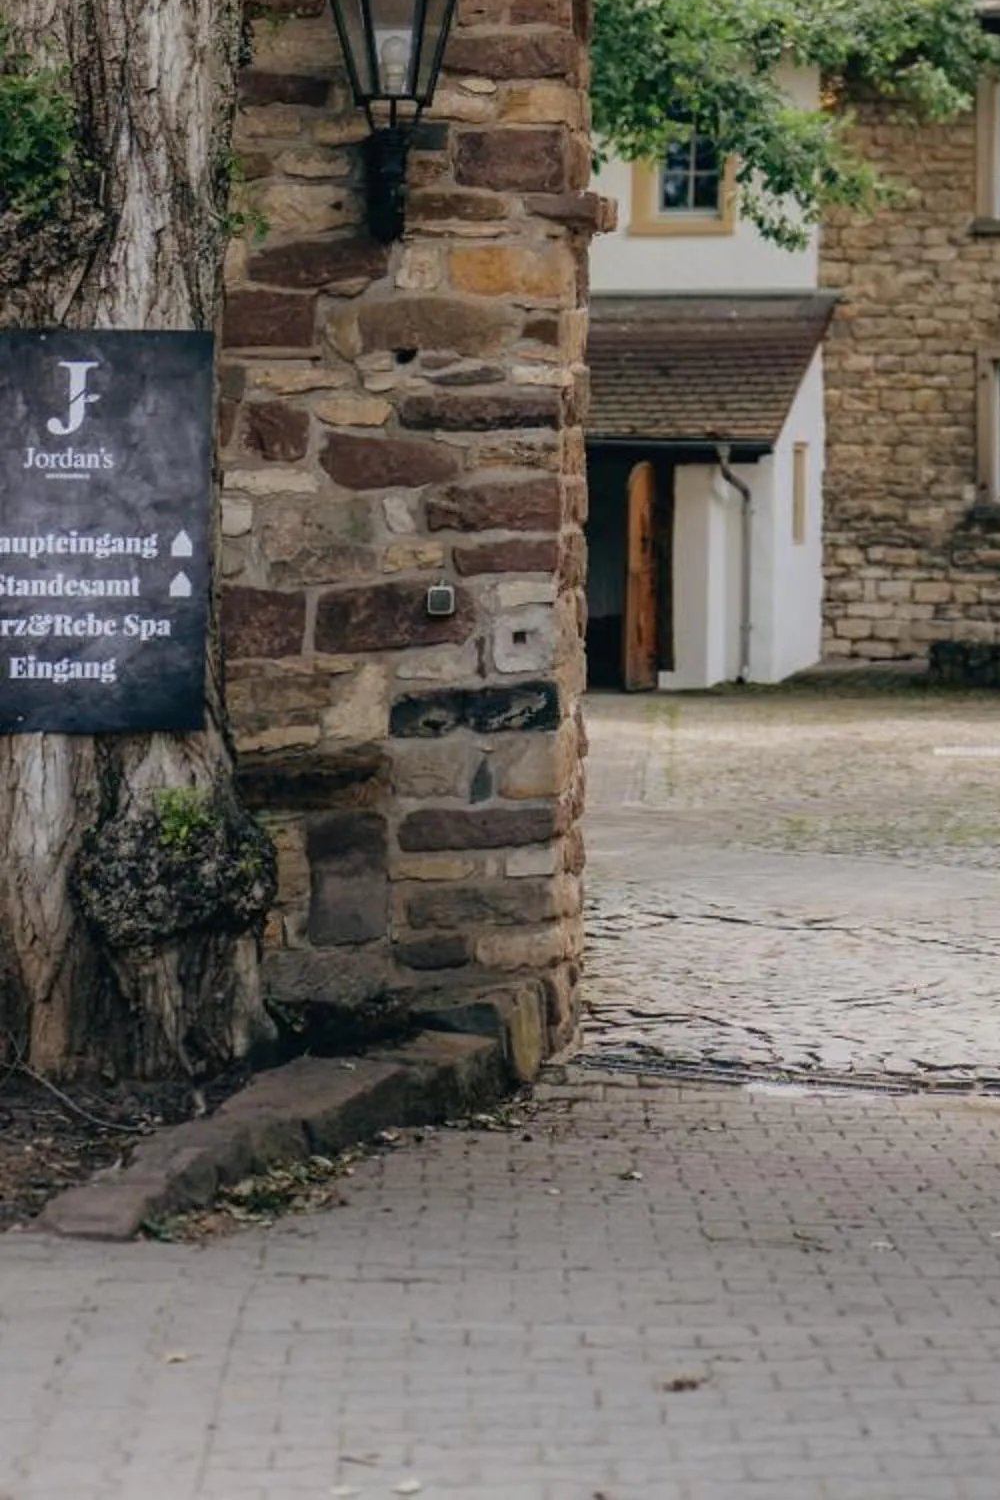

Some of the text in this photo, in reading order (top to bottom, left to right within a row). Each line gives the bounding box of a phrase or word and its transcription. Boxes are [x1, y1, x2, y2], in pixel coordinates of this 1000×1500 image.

[23, 446, 114, 469] Jordan's
[0, 531, 159, 559] aupteingang
[0, 612, 172, 641] rz&Rebe Spa
[8, 655, 118, 683] Eingang
